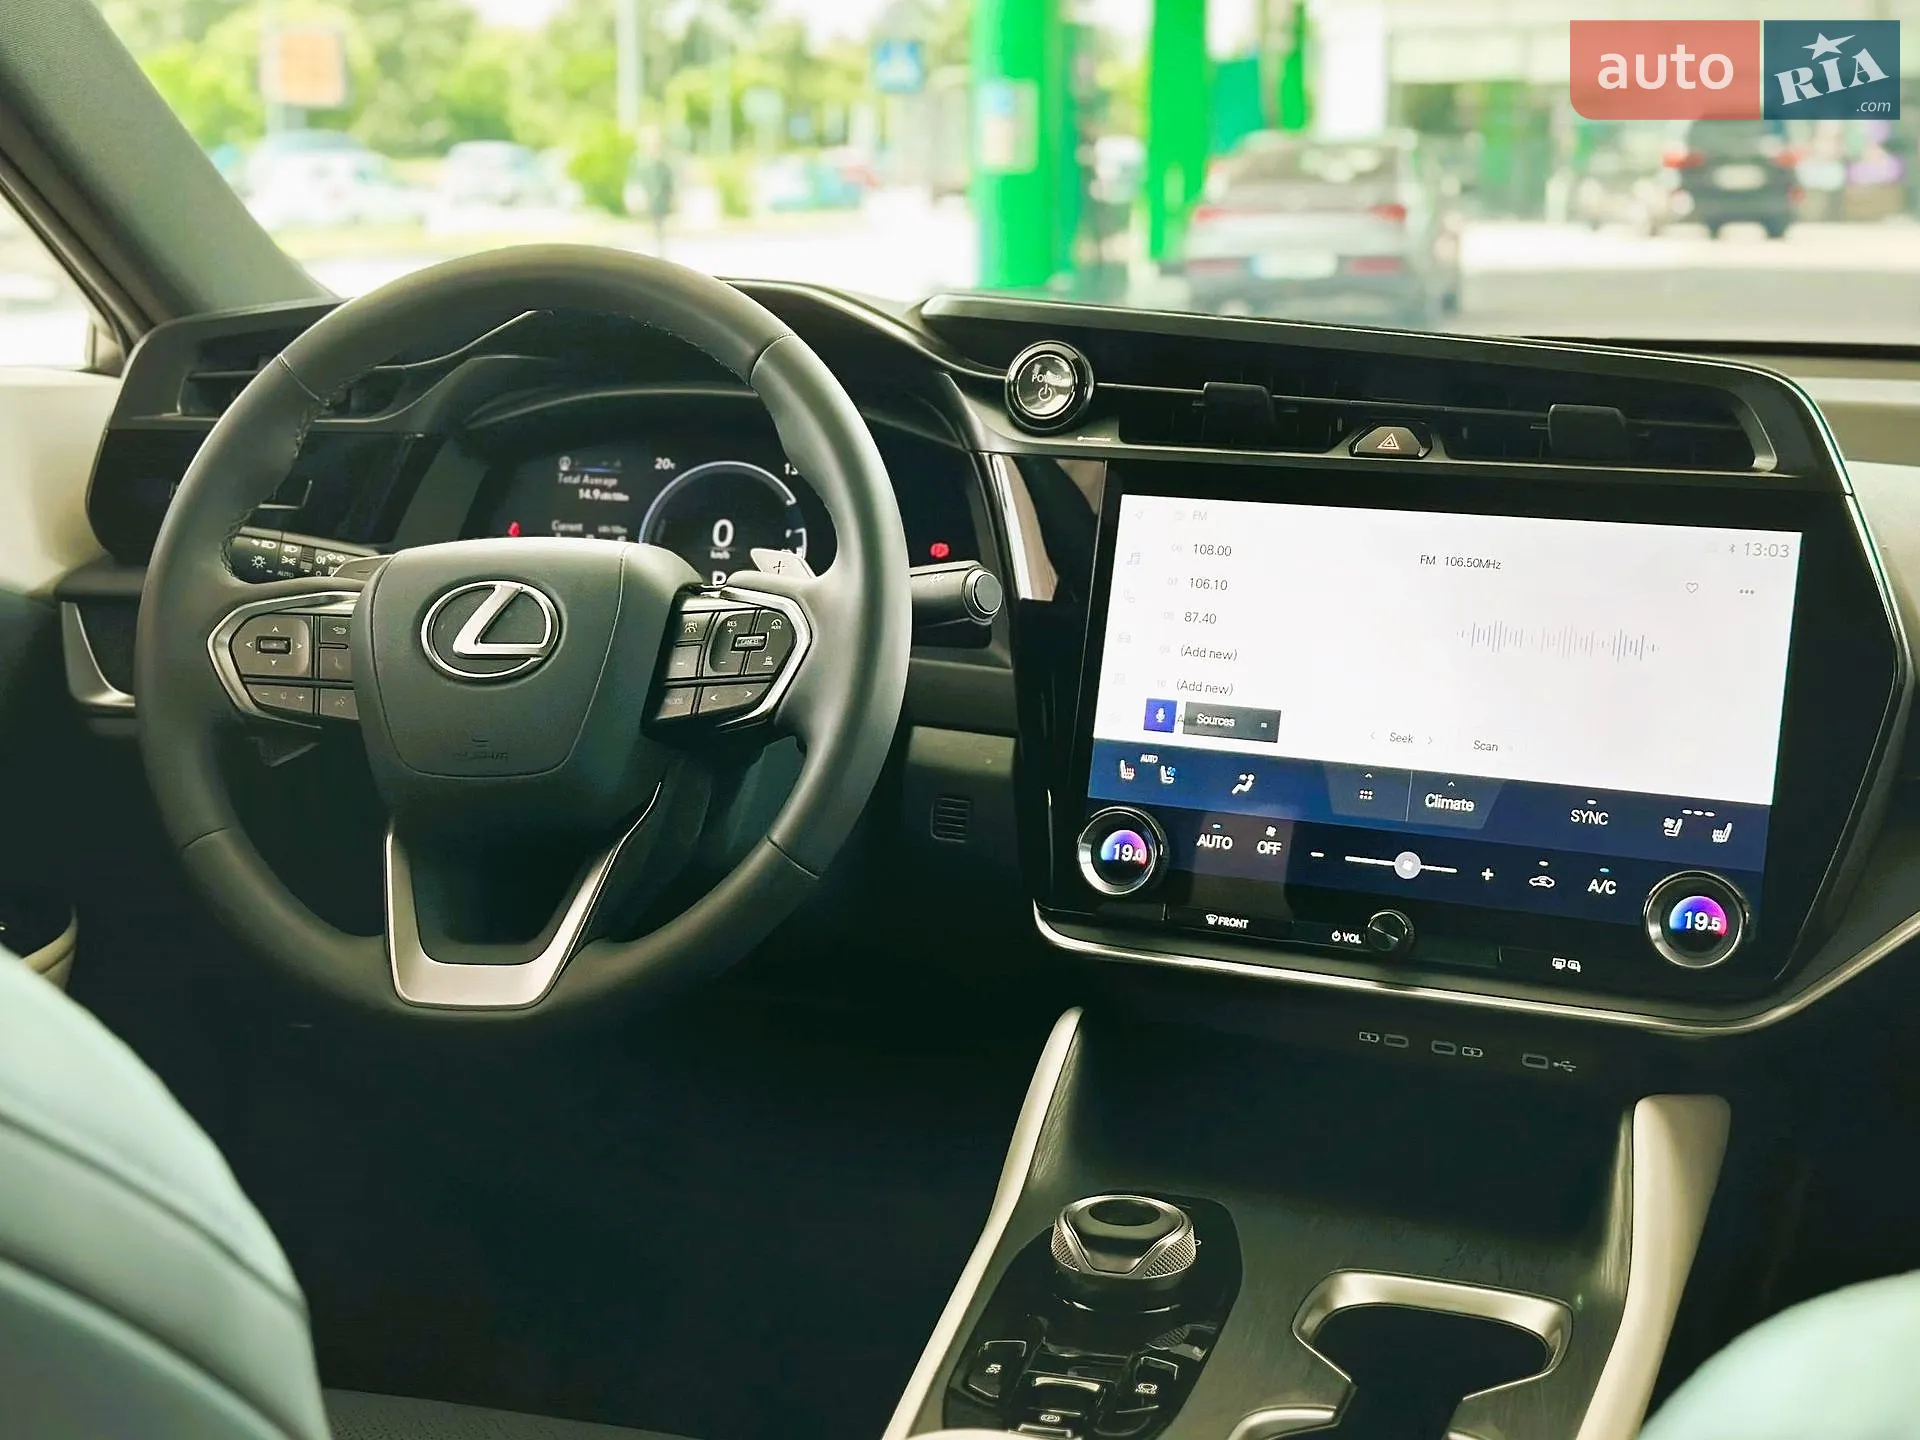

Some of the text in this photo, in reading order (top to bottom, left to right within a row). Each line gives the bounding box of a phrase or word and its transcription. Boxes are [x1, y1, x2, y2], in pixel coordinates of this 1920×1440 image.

[712, 518, 734, 548] 0
[1192, 543, 1232, 557] 108.00
[1743, 541, 1790, 558] 13:03
[1420, 555, 1502, 571] FM 106.50MHz
[1189, 577, 1228, 591] 106.10
[1184, 611, 1217, 625] 87.40
[1180, 645, 1207, 659] (Add
[1209, 648, 1238, 662] new)
[1176, 678, 1203, 693] (Add
[1205, 682, 1234, 696] new)
[1196, 713, 1235, 727] Sources
[1389, 732, 1414, 745] Seek
[1473, 740, 1499, 753] Scan
[1140, 754, 1158, 763] AUTO
[1425, 793, 1475, 812] Climate
[1570, 809, 1609, 826] SYNC
[1196, 833, 1233, 850] AUTO
[1257, 840, 1282, 856] OFF
[1112, 843, 1144, 862] 19.0
[1588, 880, 1617, 896] A/C
[1218, 916, 1249, 929] FRONT
[1684, 910, 1721, 931] 19.5
[1343, 933, 1362, 944] VOL
